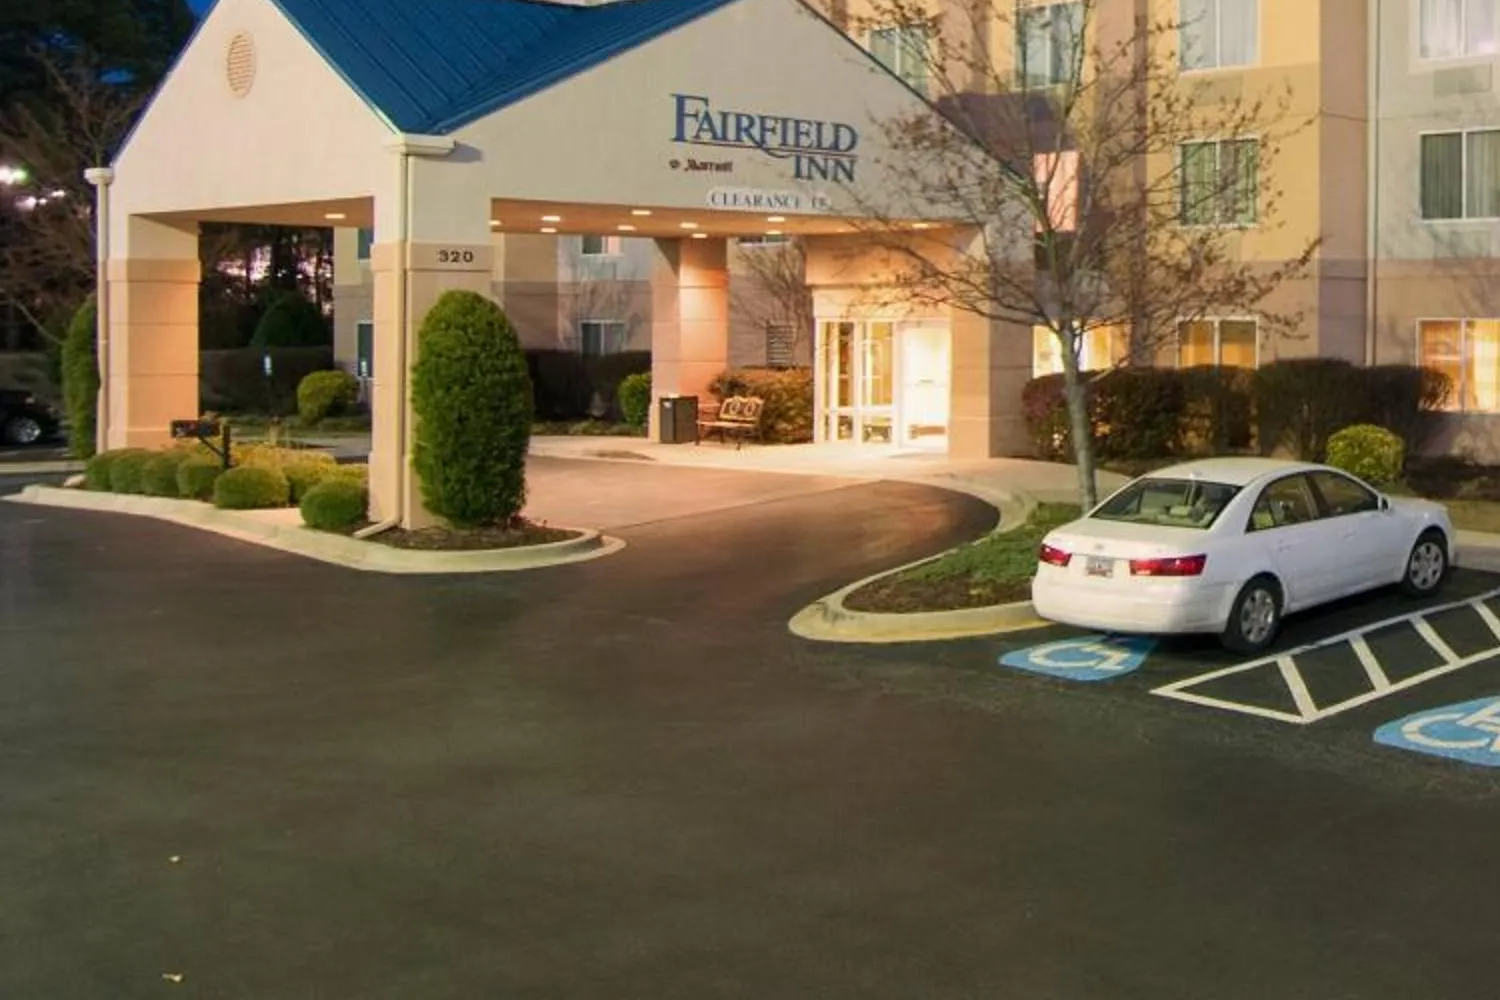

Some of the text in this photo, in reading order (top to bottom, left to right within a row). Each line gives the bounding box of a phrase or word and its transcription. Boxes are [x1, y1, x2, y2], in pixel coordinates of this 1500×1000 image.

[669, 93, 859, 156] FAIRFIELD
[793, 154, 857, 182] INN
[439, 249, 474, 263] 320
